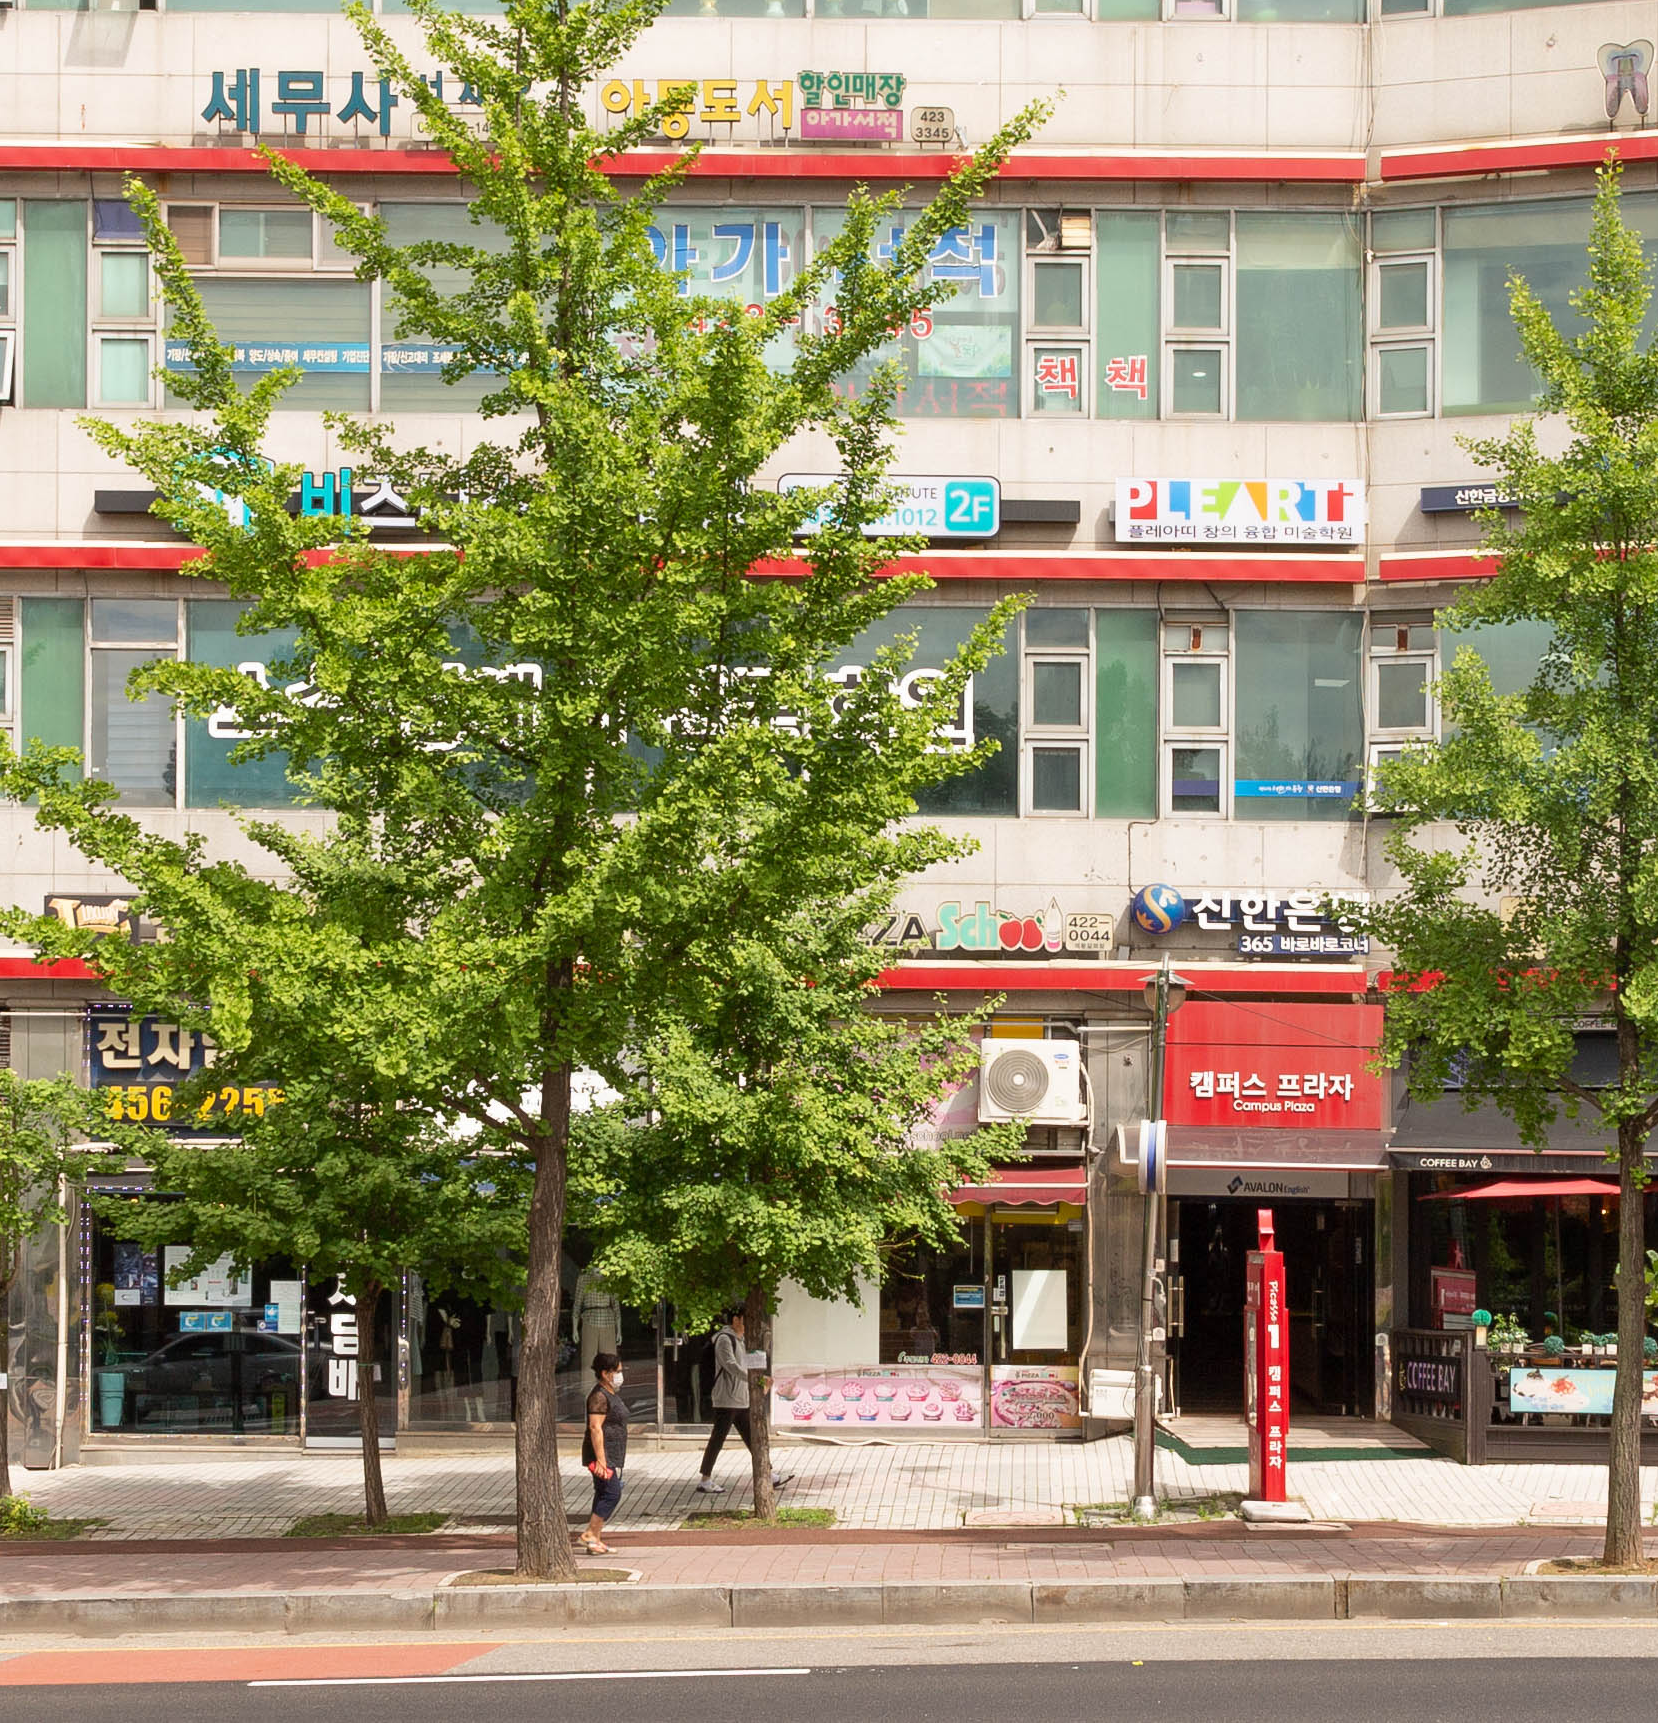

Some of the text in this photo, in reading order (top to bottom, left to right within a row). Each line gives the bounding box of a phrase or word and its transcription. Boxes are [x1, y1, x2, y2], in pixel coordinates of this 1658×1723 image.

[797, 70, 907, 110] 할인매장
[919, 111, 945, 123] 423
[915, 127, 949, 139] 3345
[1037, 354, 1080, 400] 책
[1105, 354, 1148, 401] 책
[949, 488, 991, 524] 2F
[1202, 525, 1237, 539] 창의
[1243, 525, 1278, 540] 융합
[1284, 525, 1353, 540] 미술학원
[1068, 929, 1111, 942] 0044
[1241, 935, 1369, 953] 365 바로바로코너
[1189, 1070, 1355, 1102] 캠퍼스 프라자
[1233, 1099, 1315, 1114] Campus Plaza
[1420, 1157, 1479, 1169] COFFEE BAY
[1244, 1181, 1284, 1194] AVALON
[1407, 1360, 1456, 1393] COFFEE BAY
[1267, 1425, 1283, 1470] 프라자
